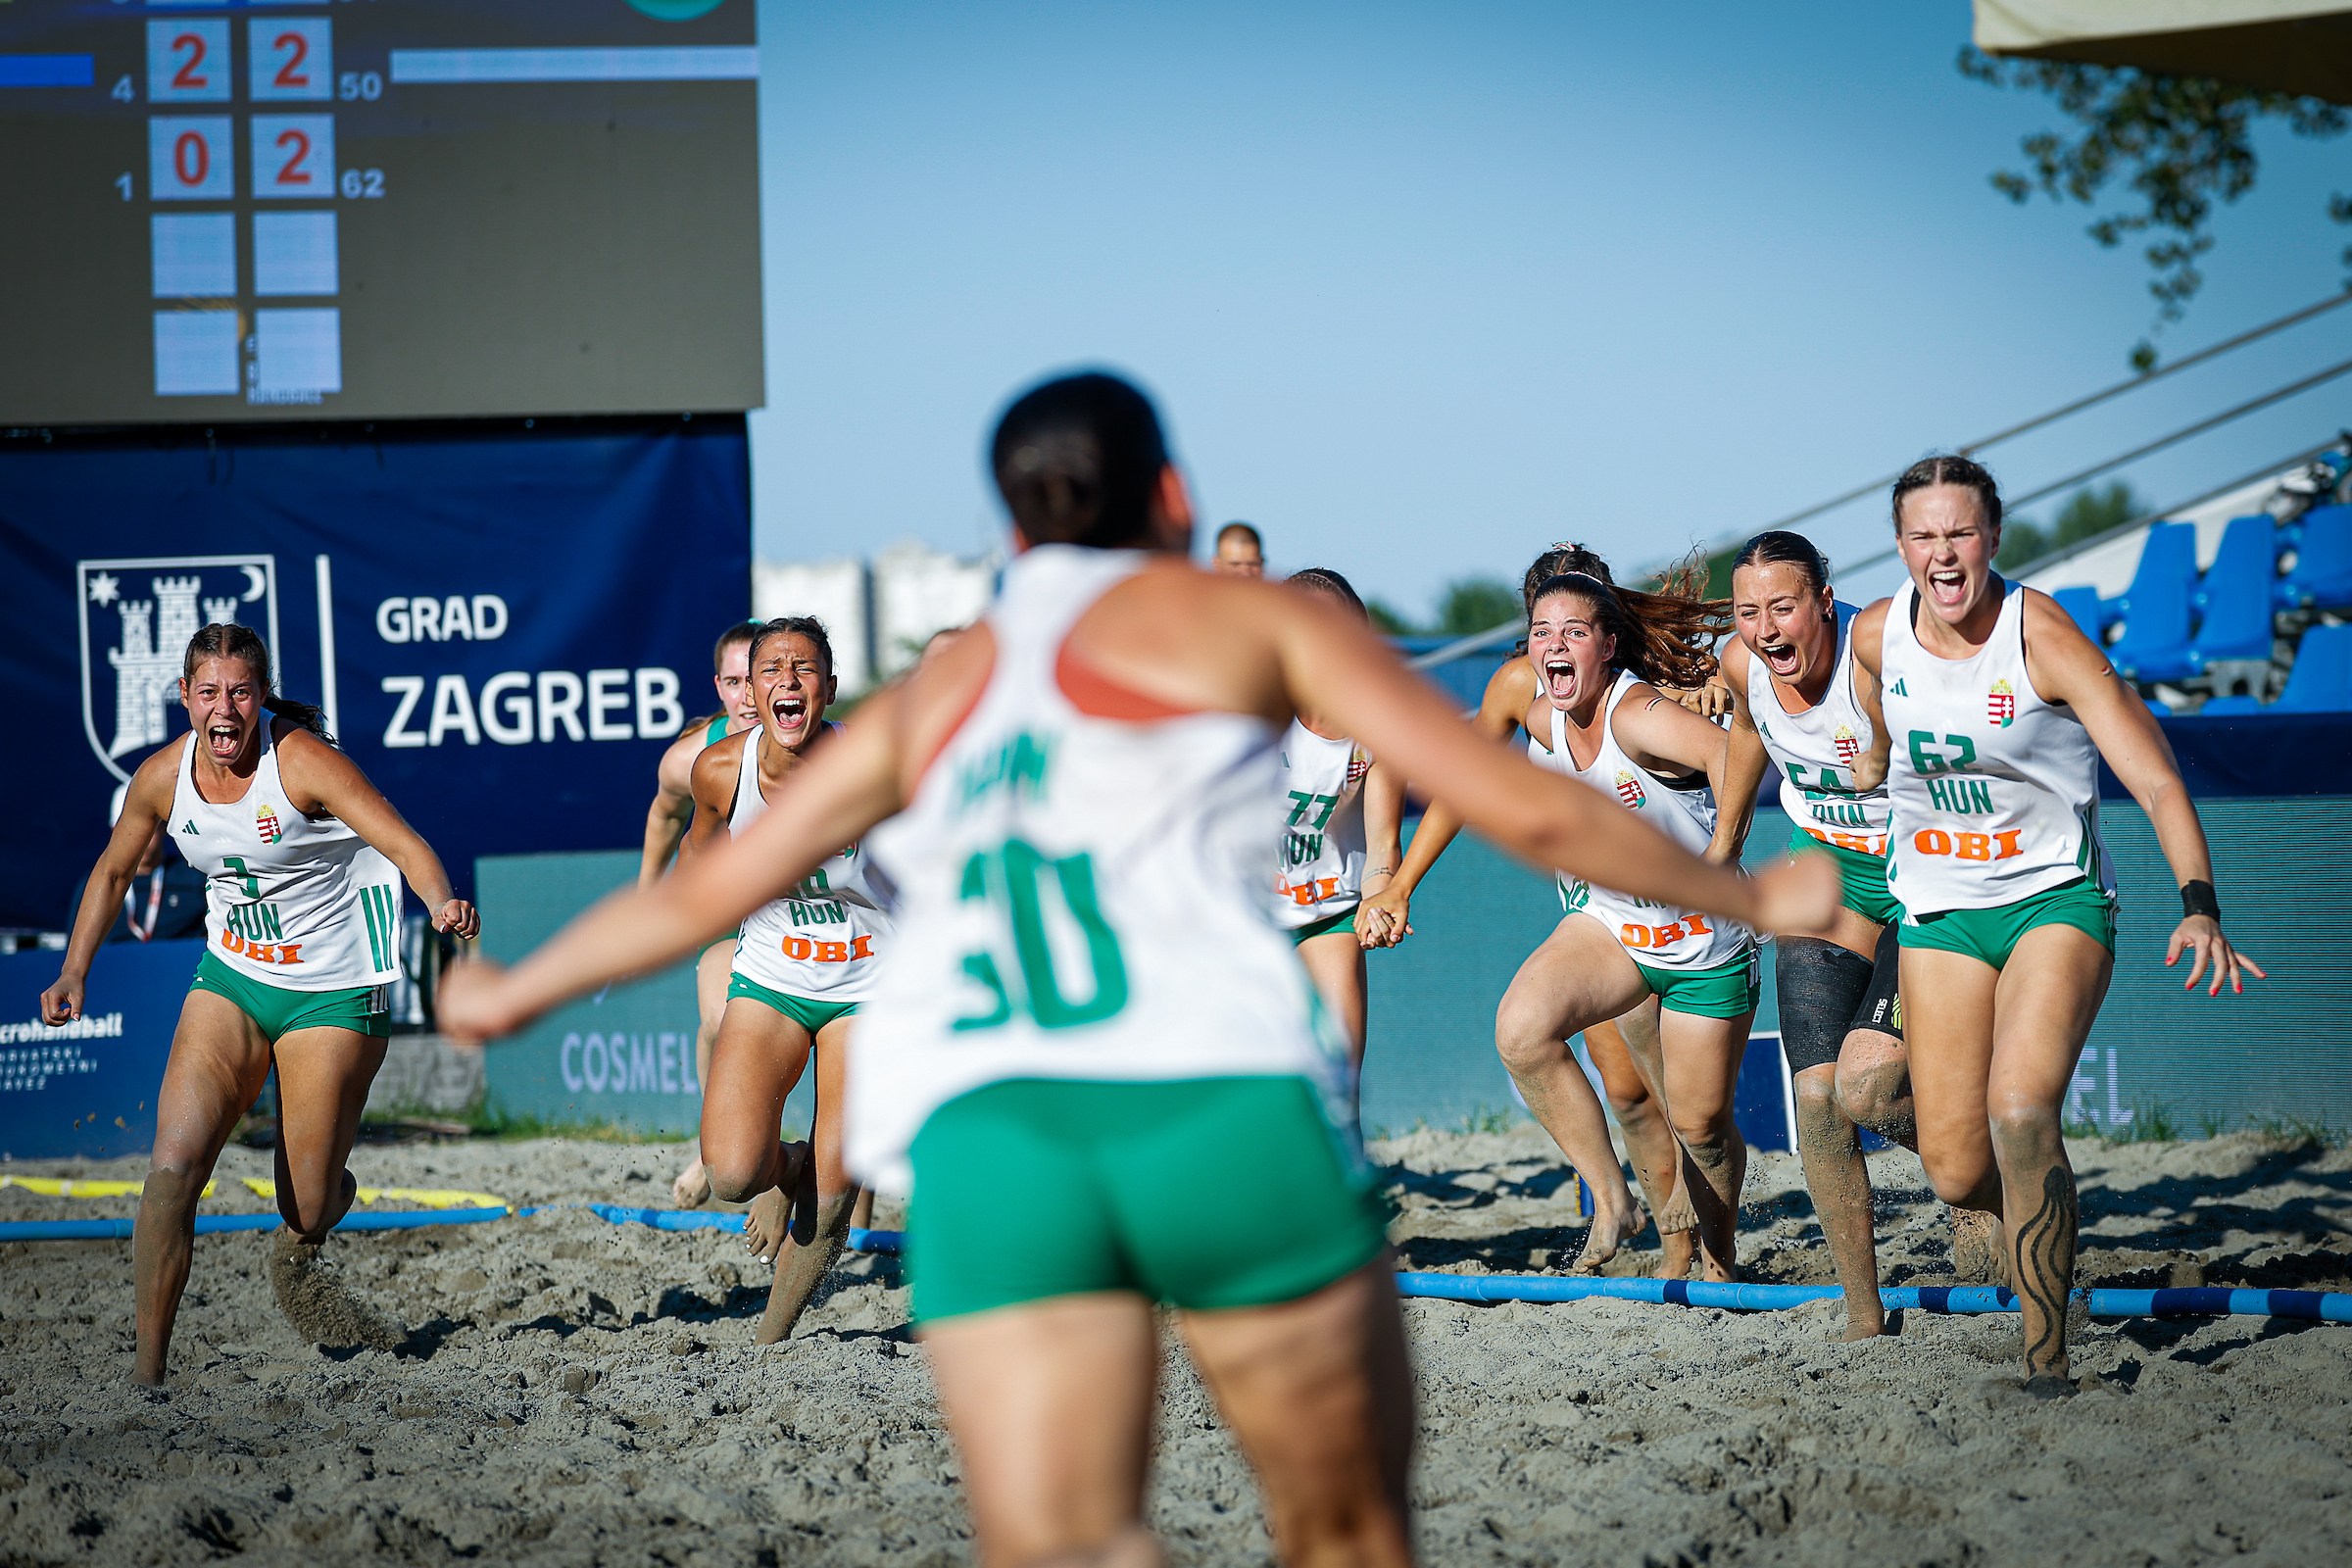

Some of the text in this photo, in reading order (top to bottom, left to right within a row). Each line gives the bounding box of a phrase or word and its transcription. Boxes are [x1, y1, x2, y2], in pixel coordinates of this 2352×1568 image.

[112, 31, 383, 103] 4 2 2 50
[115, 128, 385, 202] 1 0 2 62
[375, 594, 509, 643] GRAD
[381, 666, 685, 748] ZAGREB
[1908, 730, 1984, 775] 62
[1285, 790, 1341, 831] 77
[1926, 778, 1995, 814] HUN
[1915, 829, 2024, 860] OBI
[226, 903, 283, 941] HUN
[788, 900, 847, 927] HUN
[1620, 913, 1715, 949] OBI
[221, 928, 305, 964] OBI
[781, 934, 874, 962] OBI
[1871, 998, 1888, 1024] SELECT
[560, 1031, 700, 1095] COSMEL
